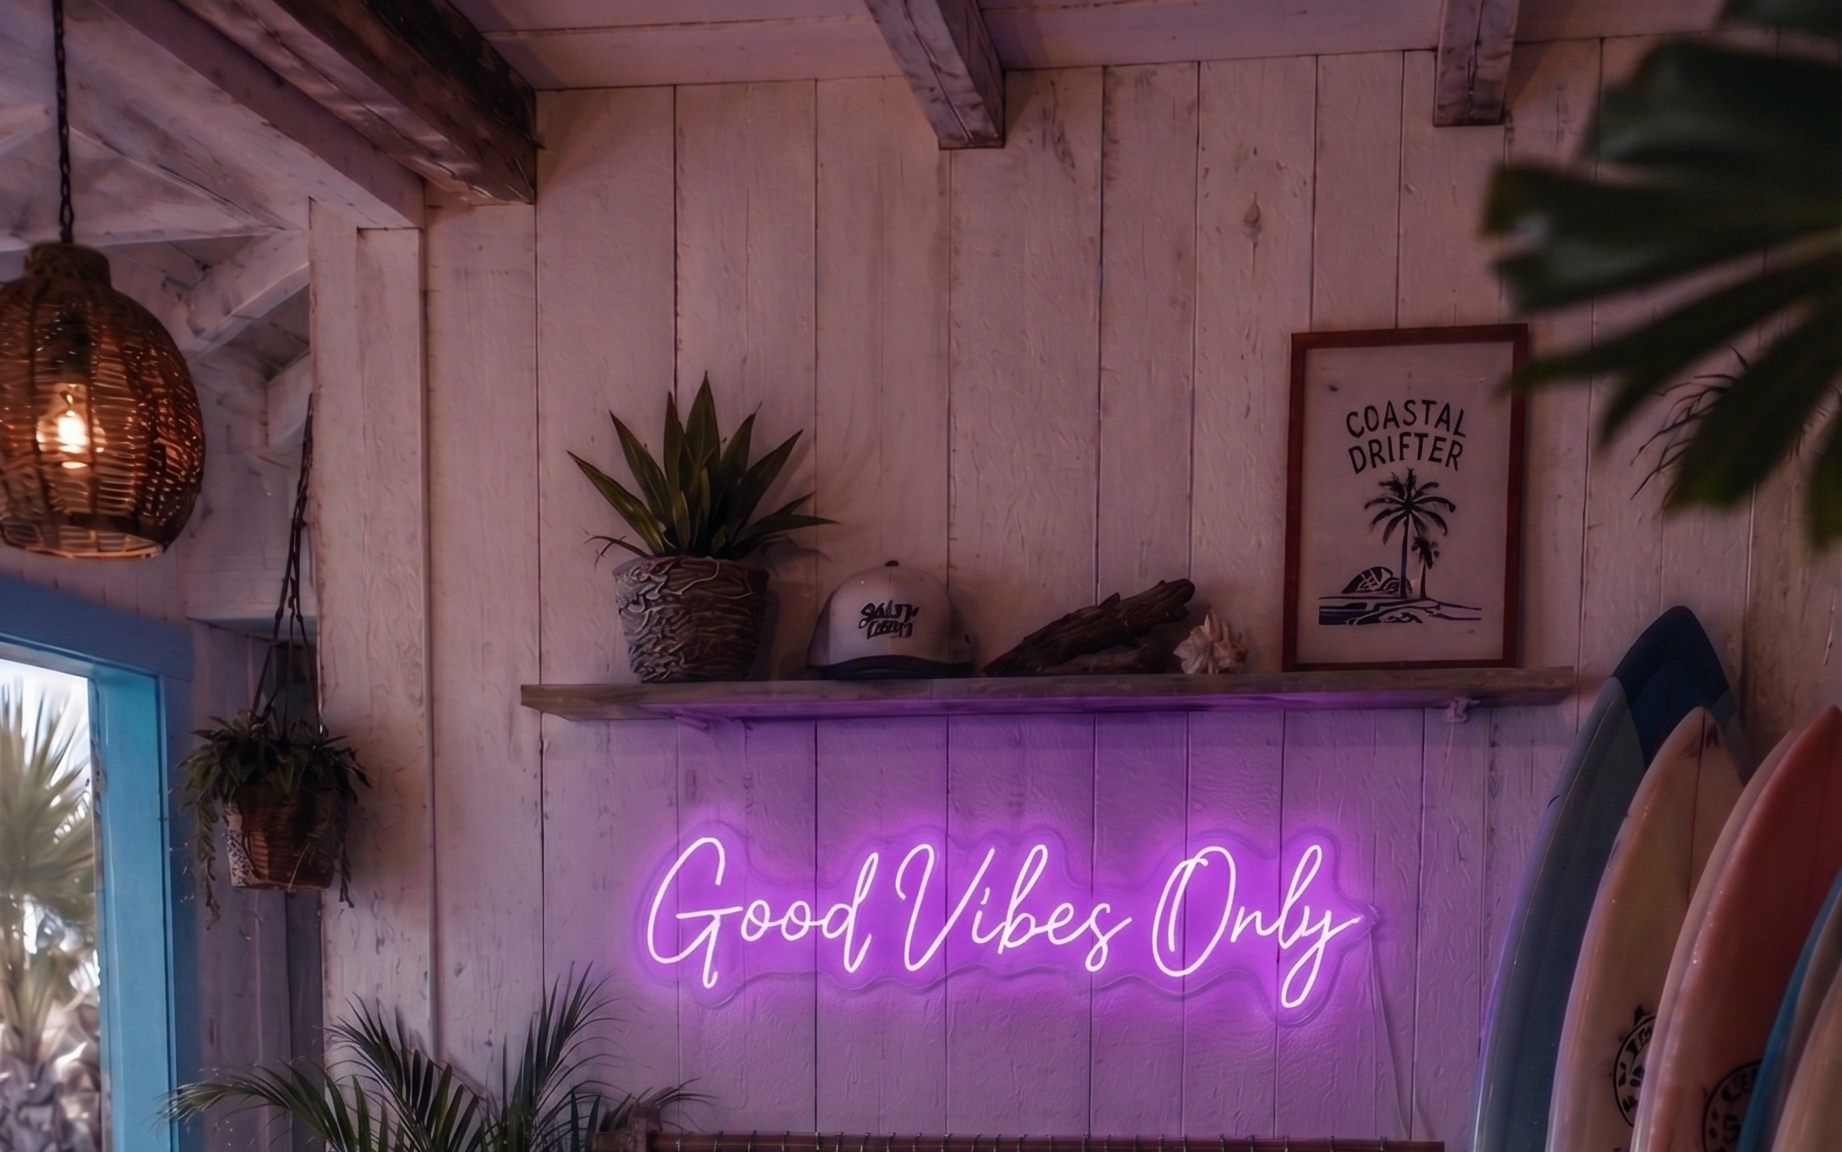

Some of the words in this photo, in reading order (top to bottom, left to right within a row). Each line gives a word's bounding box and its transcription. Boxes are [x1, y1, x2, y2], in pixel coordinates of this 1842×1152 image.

[1346, 399, 1466, 438] COASTAL
[1348, 432, 1463, 474] DRIFTER
[647, 836, 879, 988] Good
[895, 843, 1132, 972] Vibes
[1151, 845, 1360, 1008] Only
